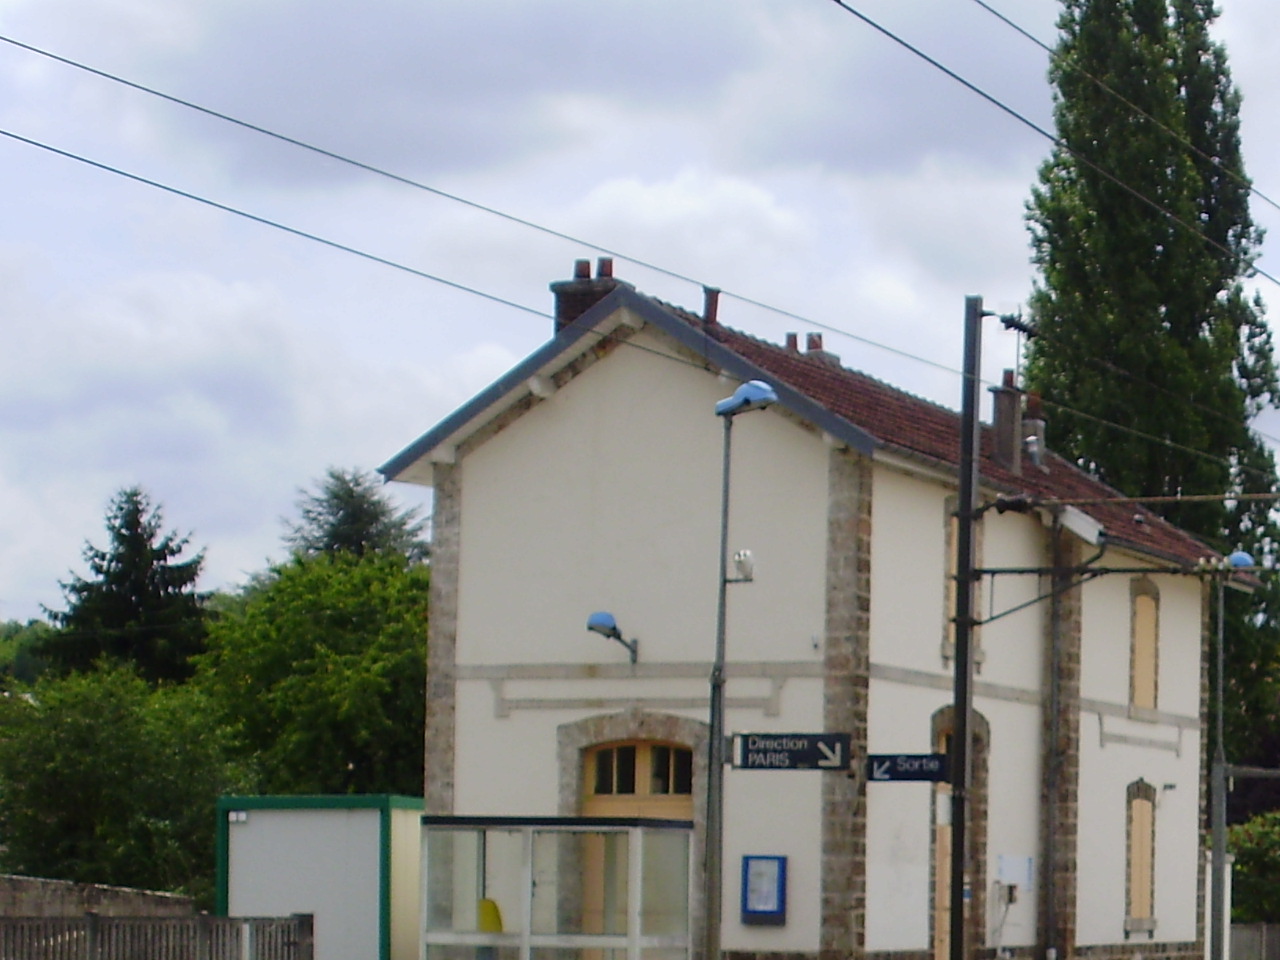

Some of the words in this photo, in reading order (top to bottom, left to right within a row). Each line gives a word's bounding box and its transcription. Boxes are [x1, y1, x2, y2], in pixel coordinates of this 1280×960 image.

[748, 737, 808, 750] Direction
[748, 752, 790, 766] PARIS
[897, 756, 939, 771] Sortie
